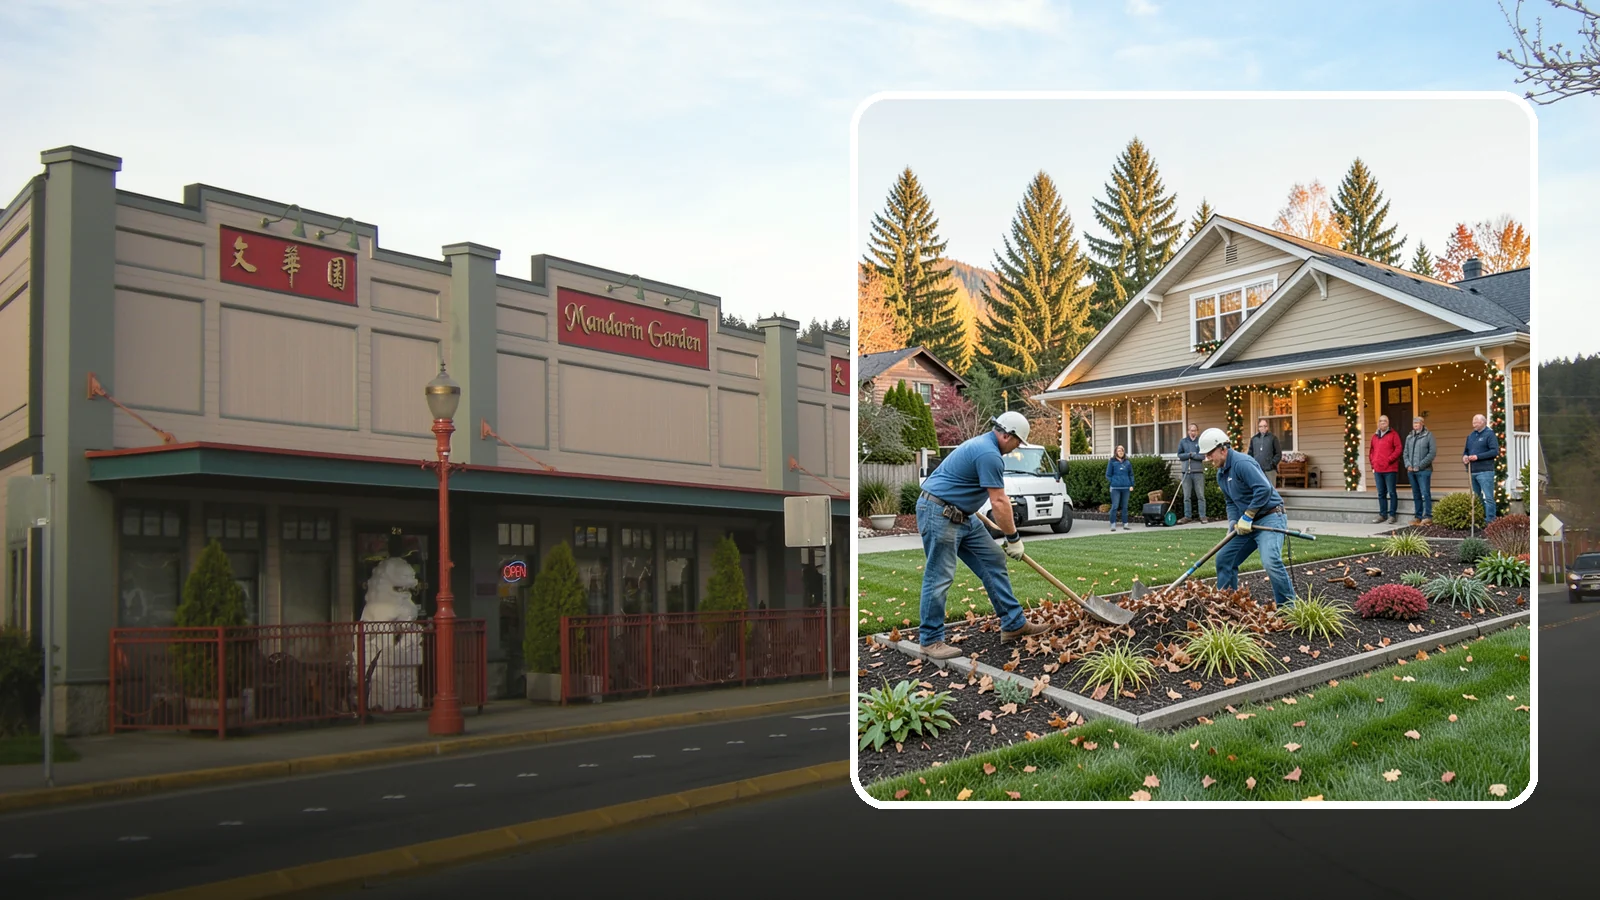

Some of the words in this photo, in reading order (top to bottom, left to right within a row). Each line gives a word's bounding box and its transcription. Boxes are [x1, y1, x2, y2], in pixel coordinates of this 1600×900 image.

[230, 236, 347, 291] 文華園
[564, 302, 644, 341] Mandarin
[648, 320, 701, 352] Garden
[503, 565, 527, 578] OPEN
